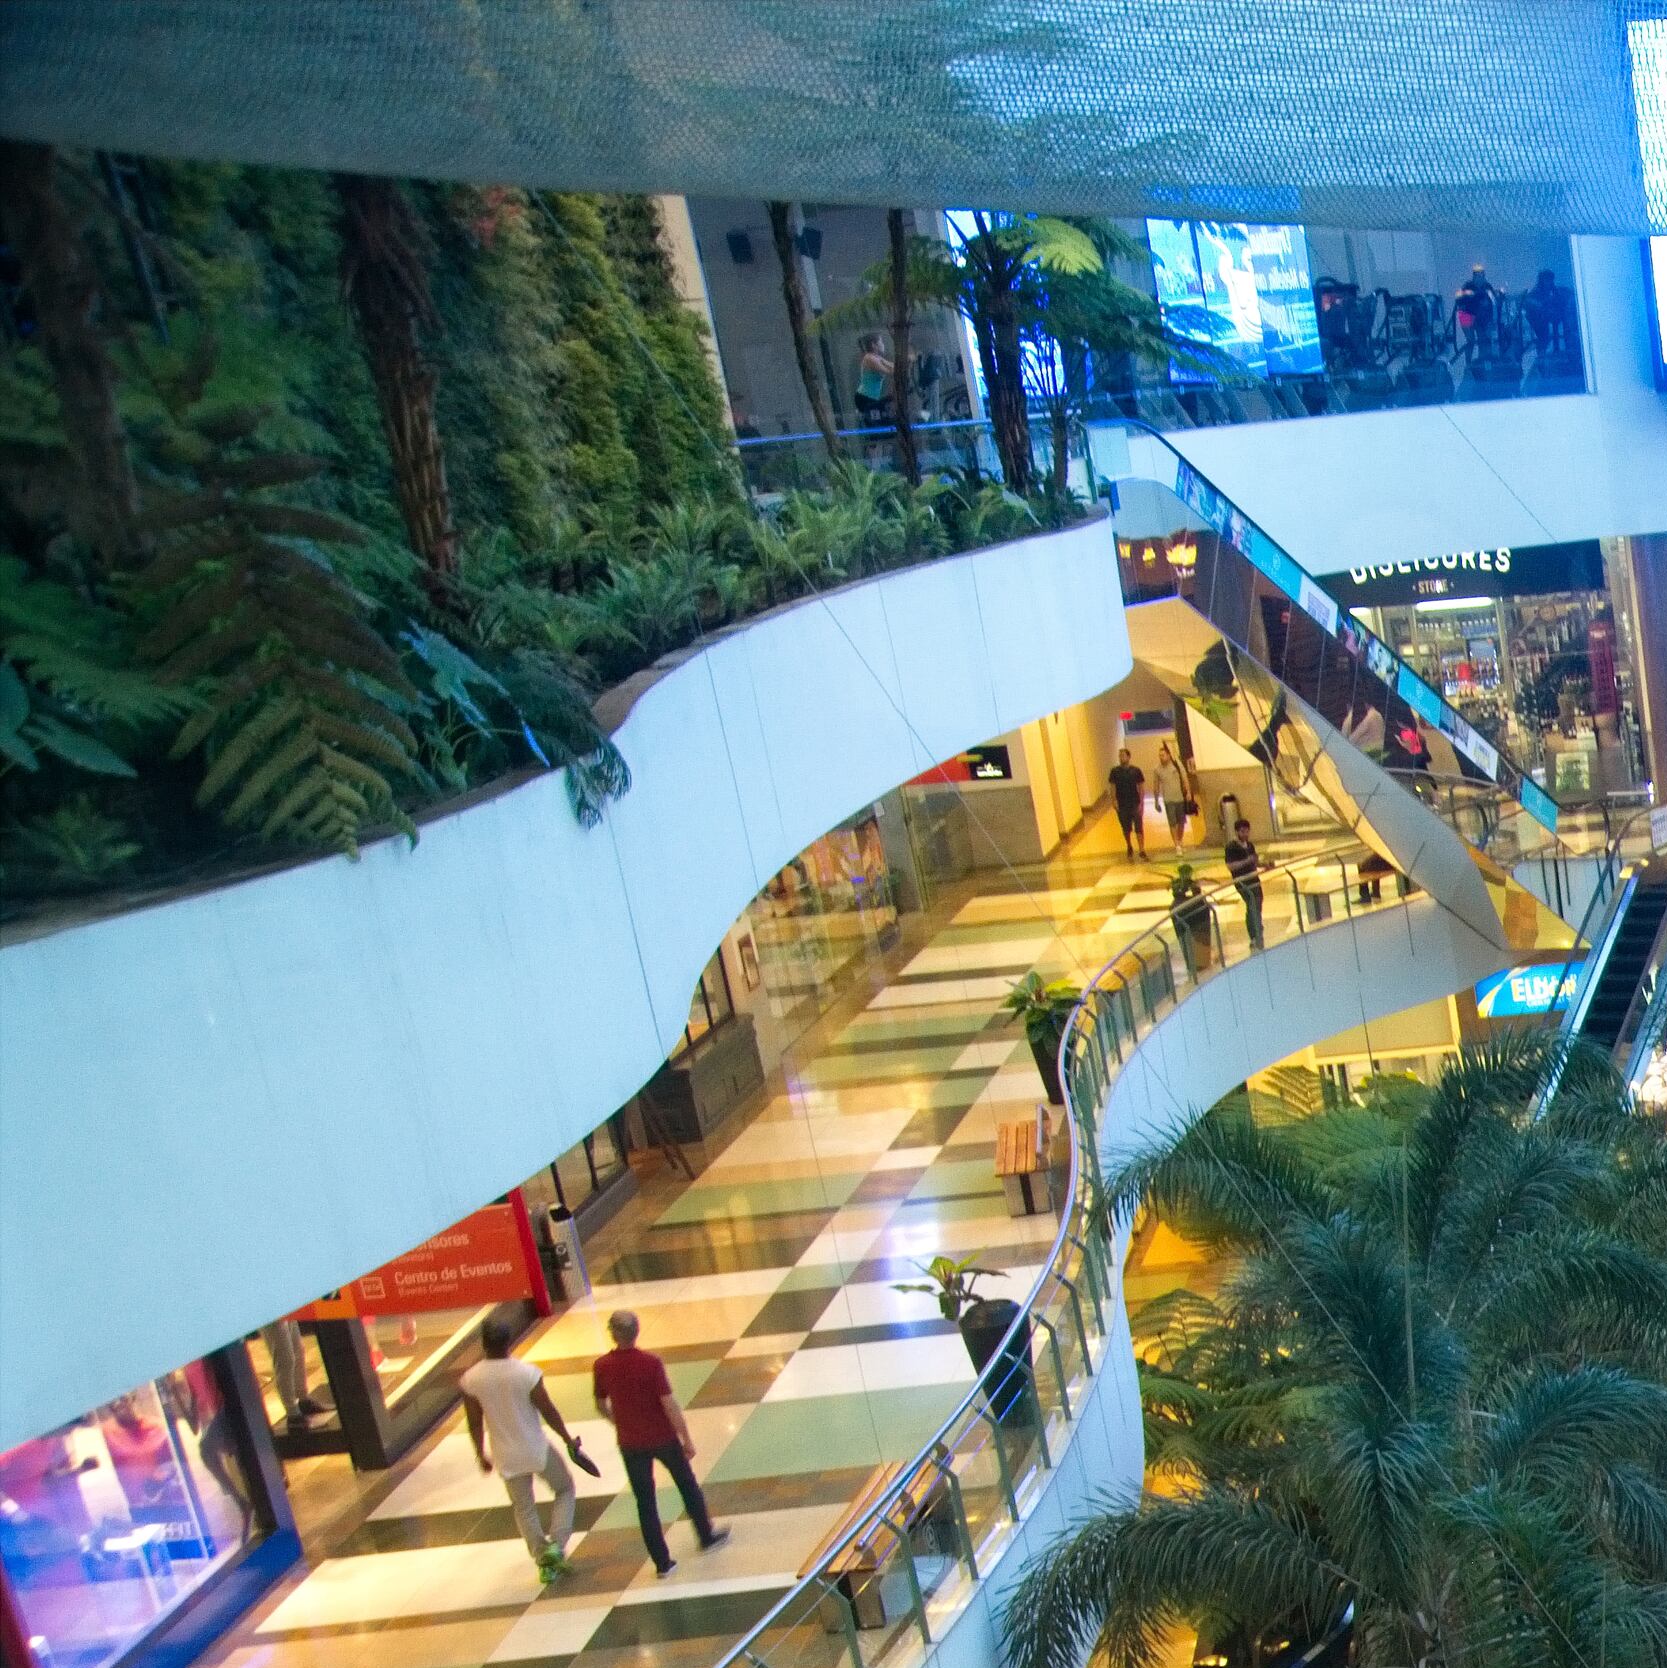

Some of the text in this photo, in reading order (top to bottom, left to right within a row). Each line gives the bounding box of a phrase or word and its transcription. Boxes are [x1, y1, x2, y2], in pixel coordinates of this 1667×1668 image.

[394, 1260, 513, 1286] Centro de Eventos
